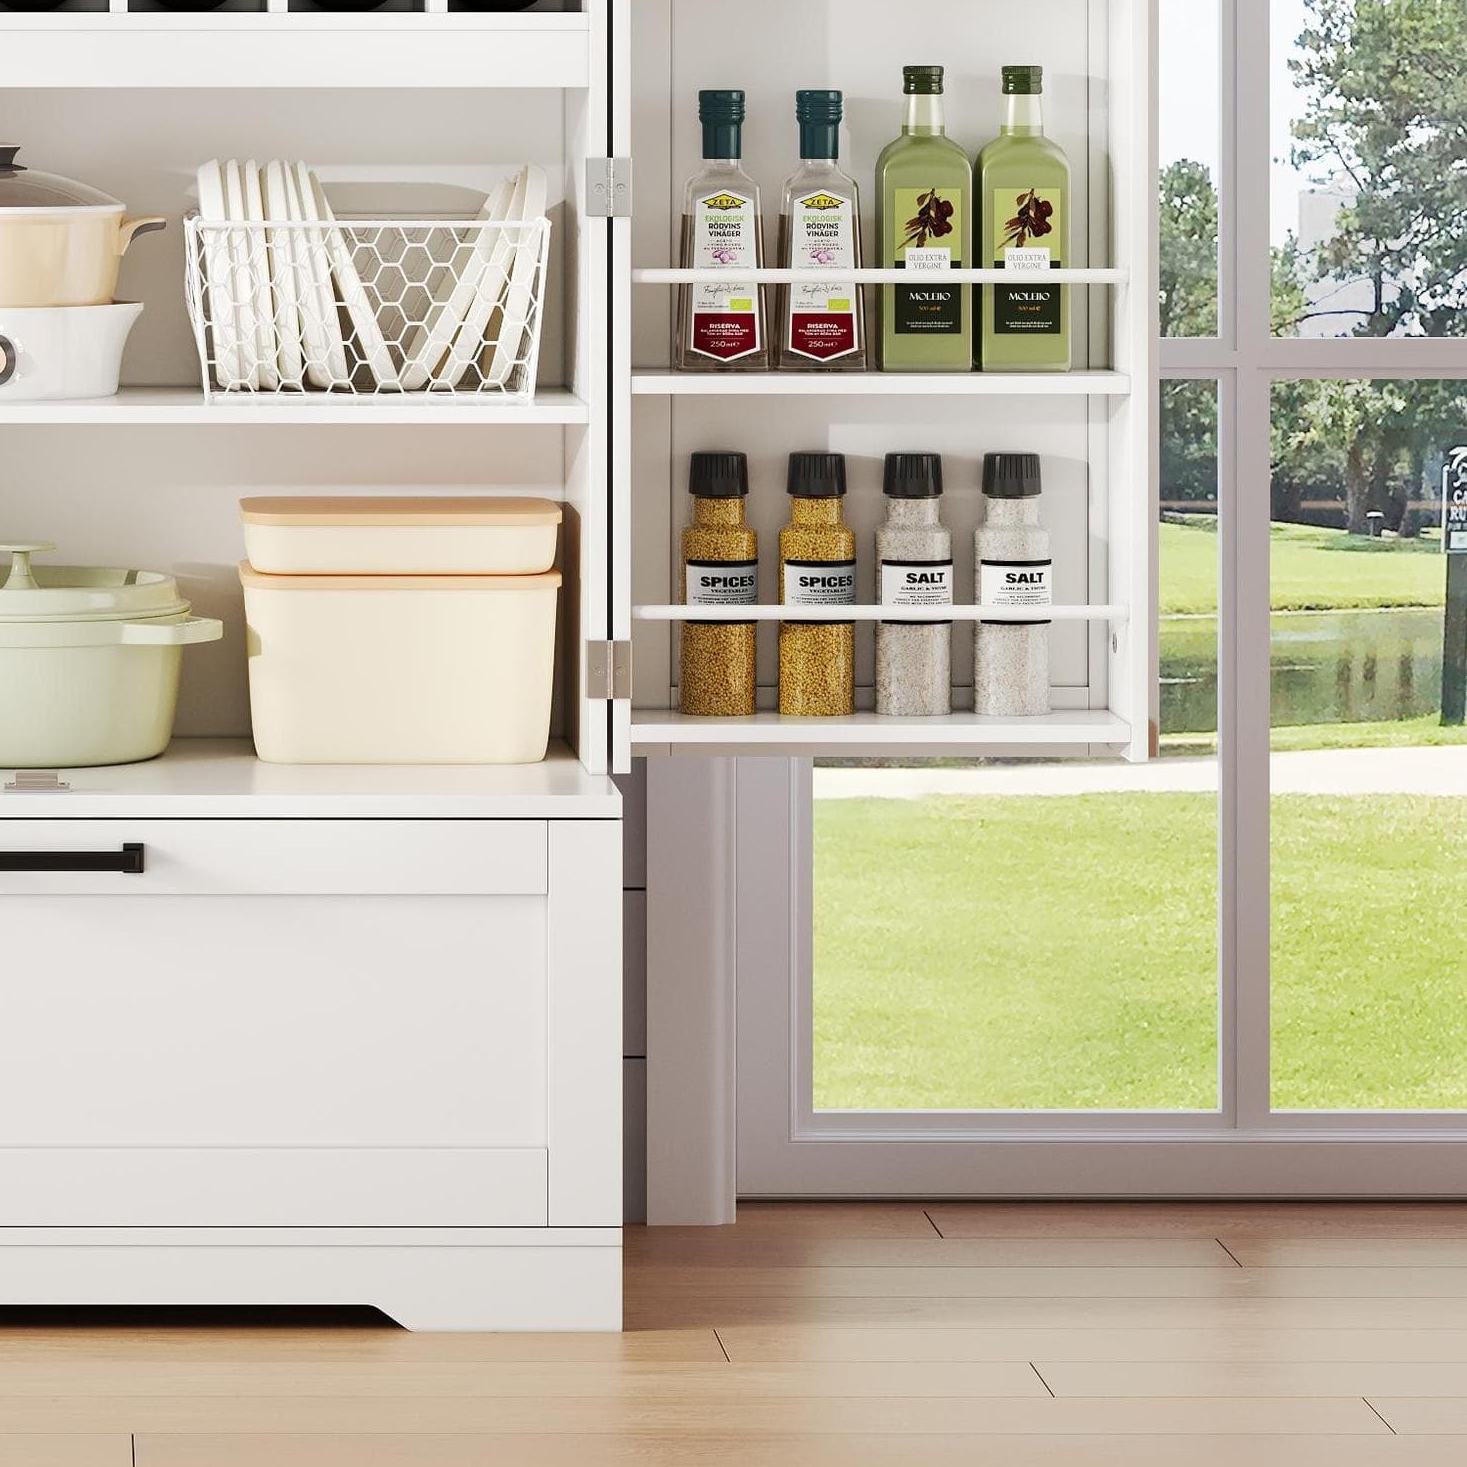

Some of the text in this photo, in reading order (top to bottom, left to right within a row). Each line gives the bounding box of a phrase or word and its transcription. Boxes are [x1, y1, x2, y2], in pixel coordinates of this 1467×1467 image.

[700, 575, 754, 587] SPICES
[799, 575, 852, 587] SPICES
[906, 572, 945, 583] SALT
[1005, 572, 1044, 583] SALT
